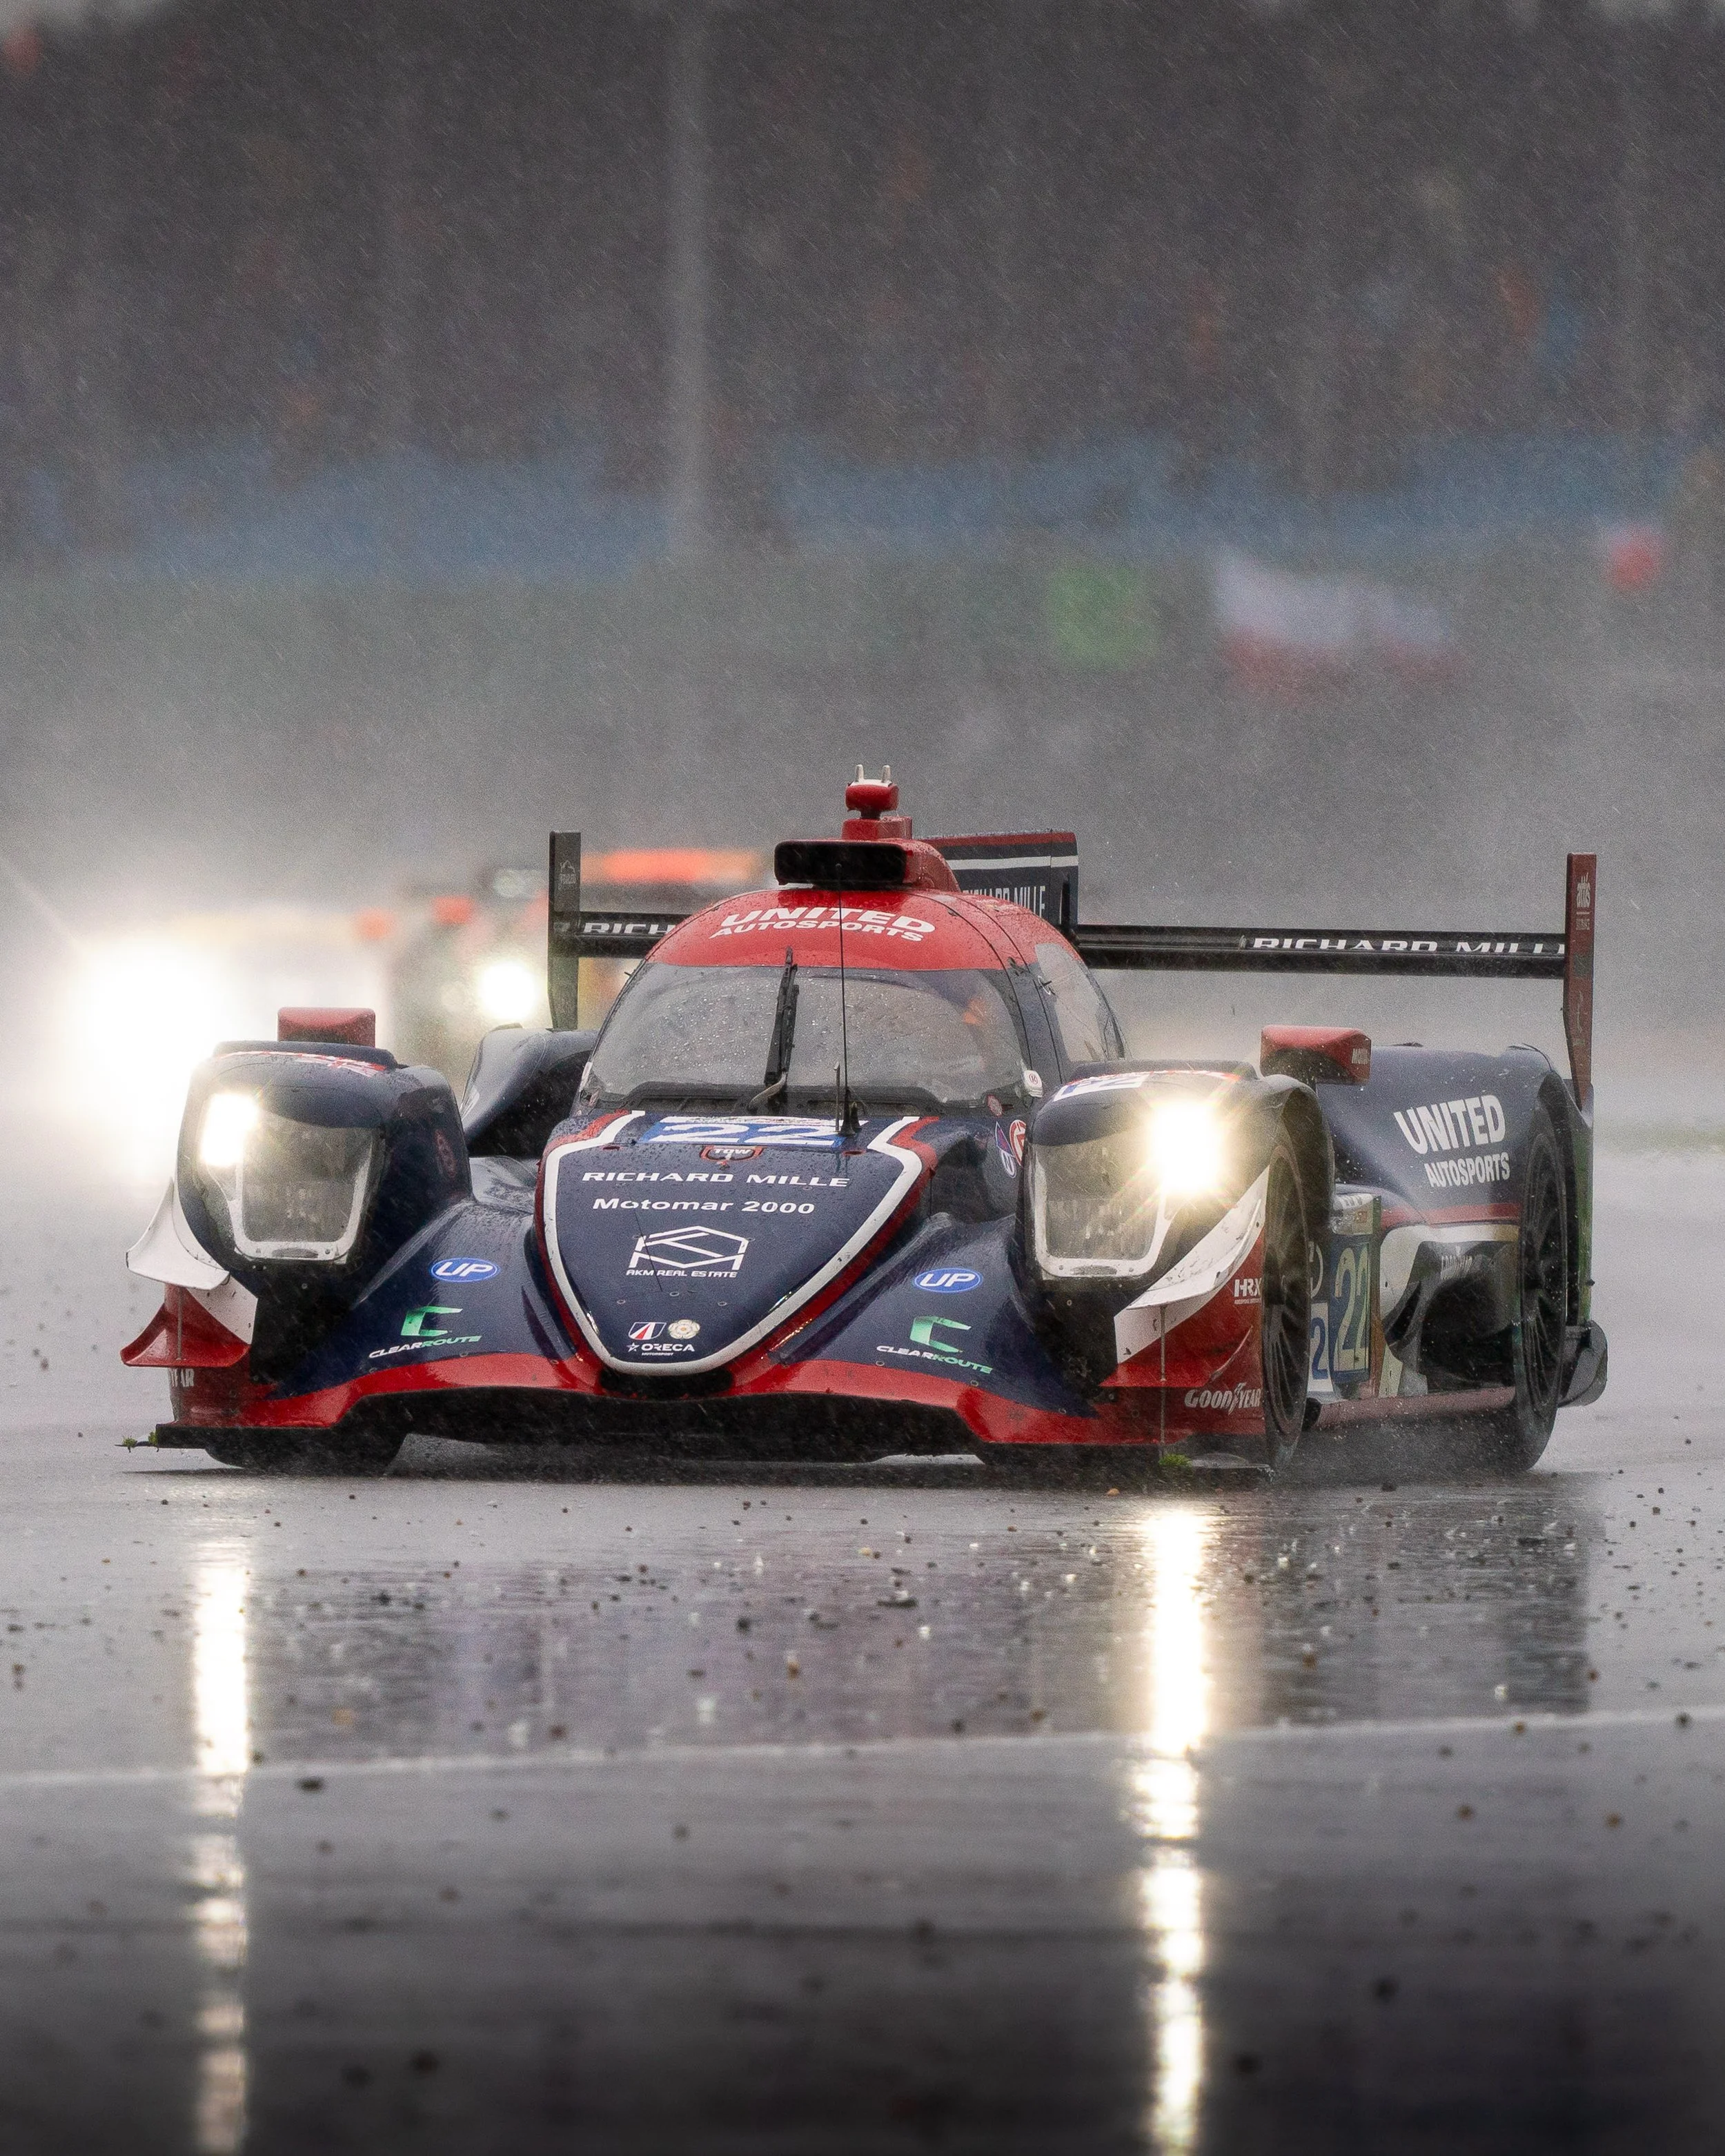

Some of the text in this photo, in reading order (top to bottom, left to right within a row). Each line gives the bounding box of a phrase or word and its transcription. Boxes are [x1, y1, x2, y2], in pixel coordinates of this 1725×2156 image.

[584, 922, 676, 934] RICH
[721, 907, 936, 932] UNITED
[709, 920, 925, 942] AUTOSPORTS
[1252, 938, 1437, 951] RICHARD
[649, 1123, 839, 1145] 22
[1393, 1095, 1506, 1154] UNITED
[1423, 1151, 1510, 1187] AUTOSPORTS
[582, 1172, 850, 1187] RICHARD MILLE
[593, 1198, 815, 1214] Motomar 2000
[435, 1262, 493, 1276] UP
[920, 1273, 976, 1287] UP
[1234, 1278, 1262, 1297] HRX
[368, 1336, 482, 1358] CLEARROUTE
[641, 1343, 695, 1352] ORECA
[876, 1345, 994, 1374] CLEARROUTE
[1185, 1383, 1261, 1414] GOODYEAR
